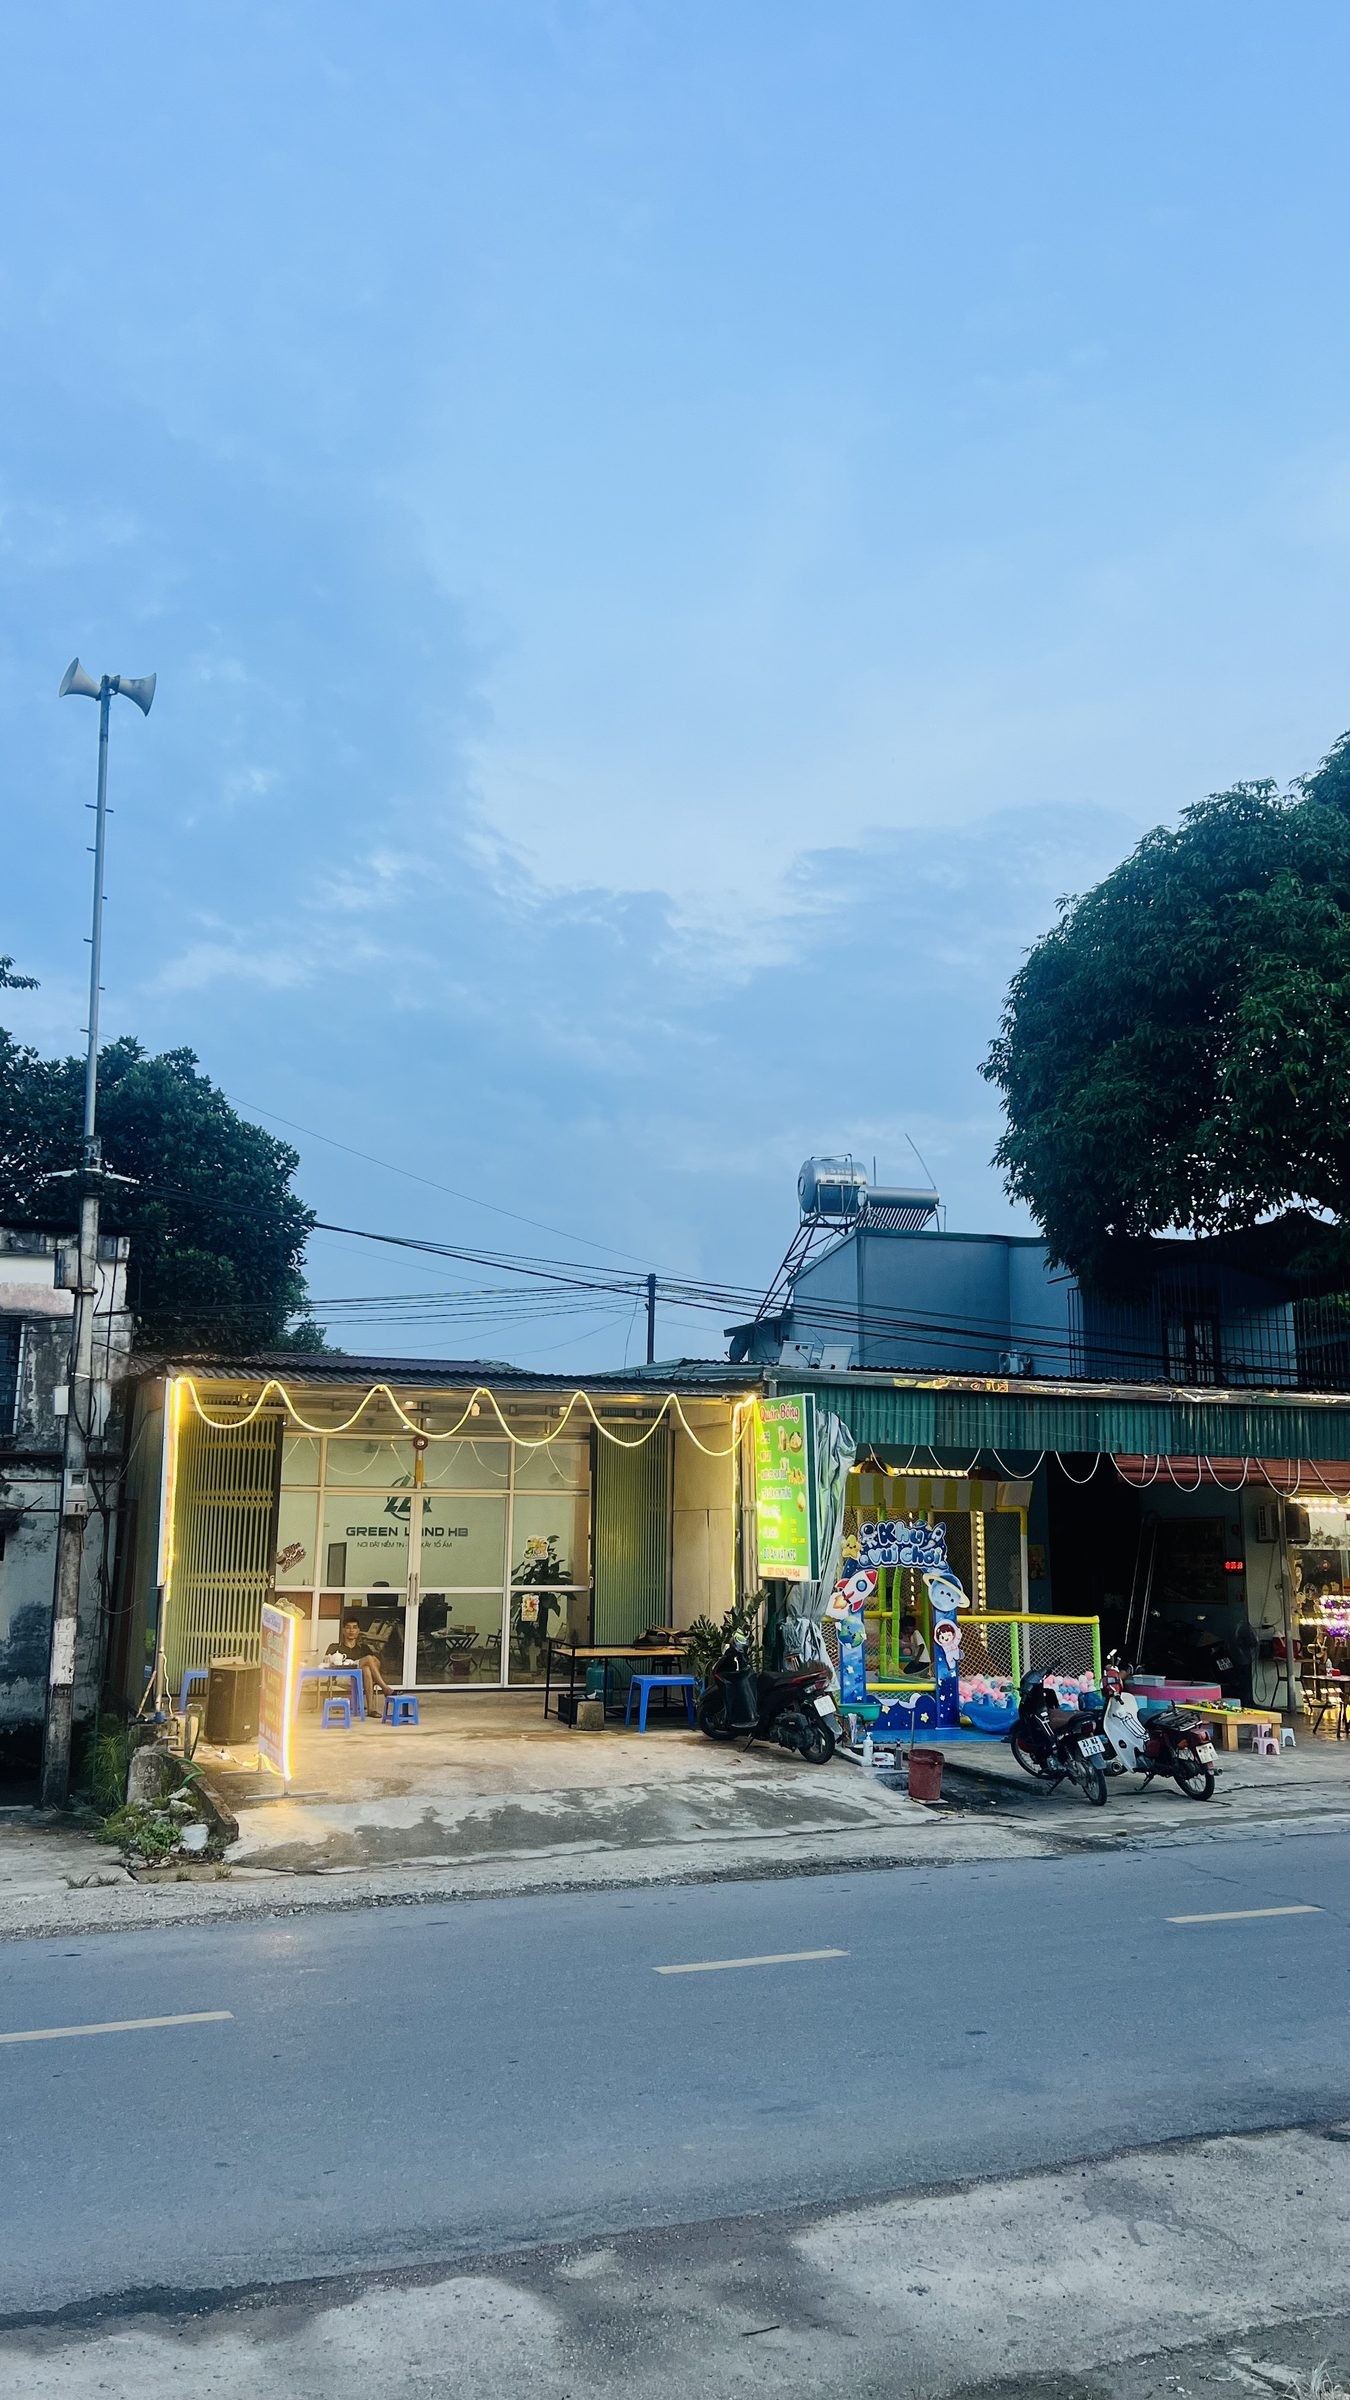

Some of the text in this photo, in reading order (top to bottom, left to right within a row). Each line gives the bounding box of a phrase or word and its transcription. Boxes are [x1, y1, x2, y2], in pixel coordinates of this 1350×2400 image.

[346, 1527, 469, 1537] GREEN LND HB
[877, 1520, 924, 1545] Khu
[867, 1542, 942, 1566] vui chơi
